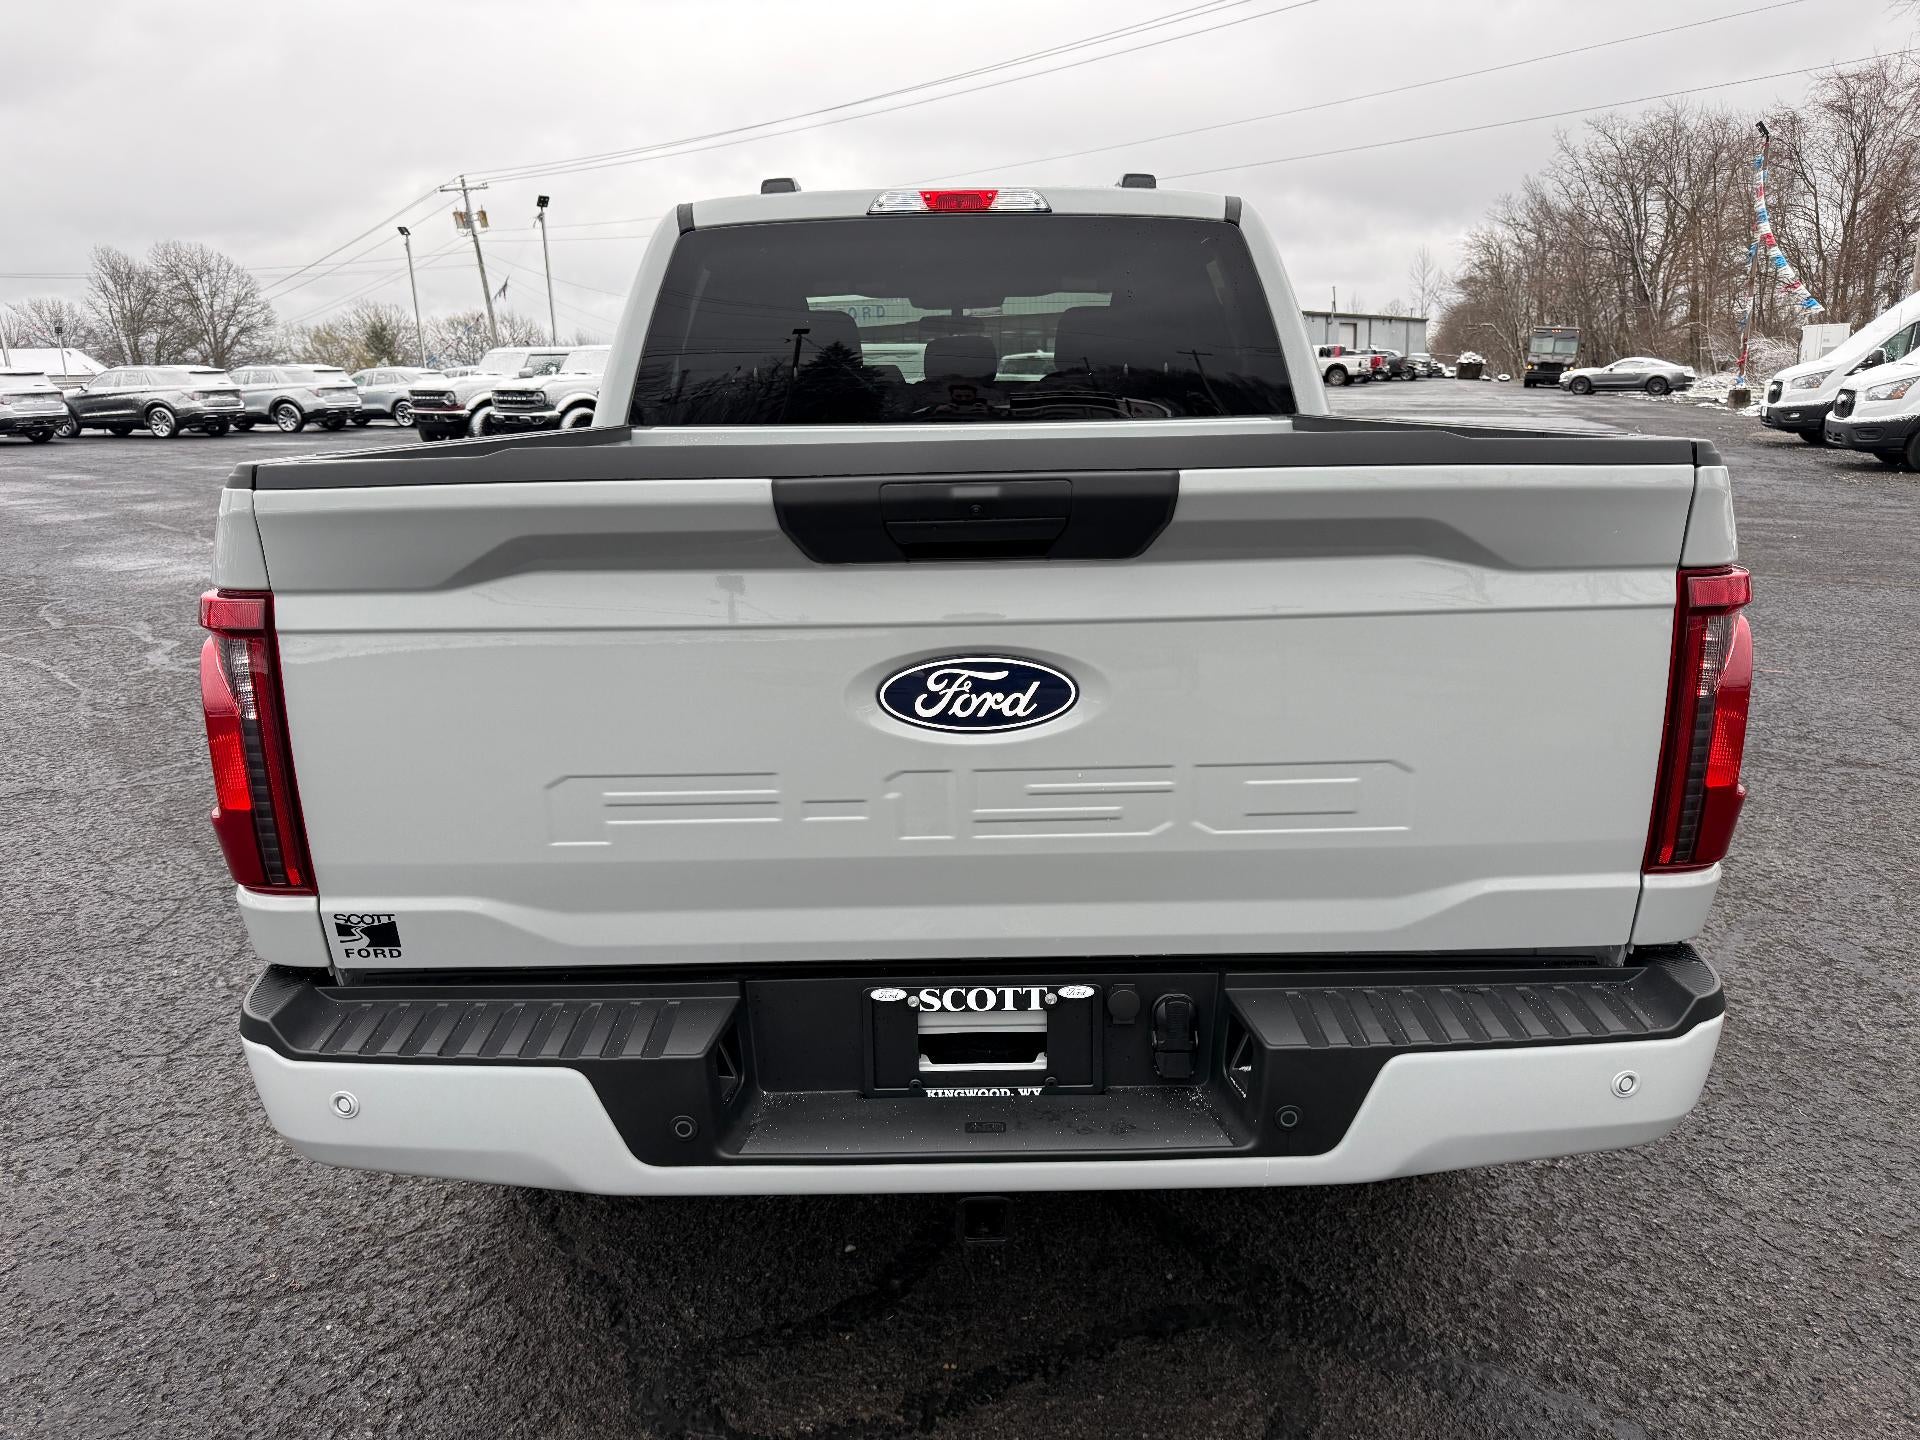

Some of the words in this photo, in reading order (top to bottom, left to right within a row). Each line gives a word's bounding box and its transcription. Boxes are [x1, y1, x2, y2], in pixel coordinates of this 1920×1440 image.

[842, 304, 886, 320] ORD
[914, 668, 1041, 718] Ford
[544, 759, 1414, 846] F-150
[333, 913, 395, 925] SCOTT
[344, 948, 402, 958] FORD
[919, 987, 1048, 1011] SCOTT
